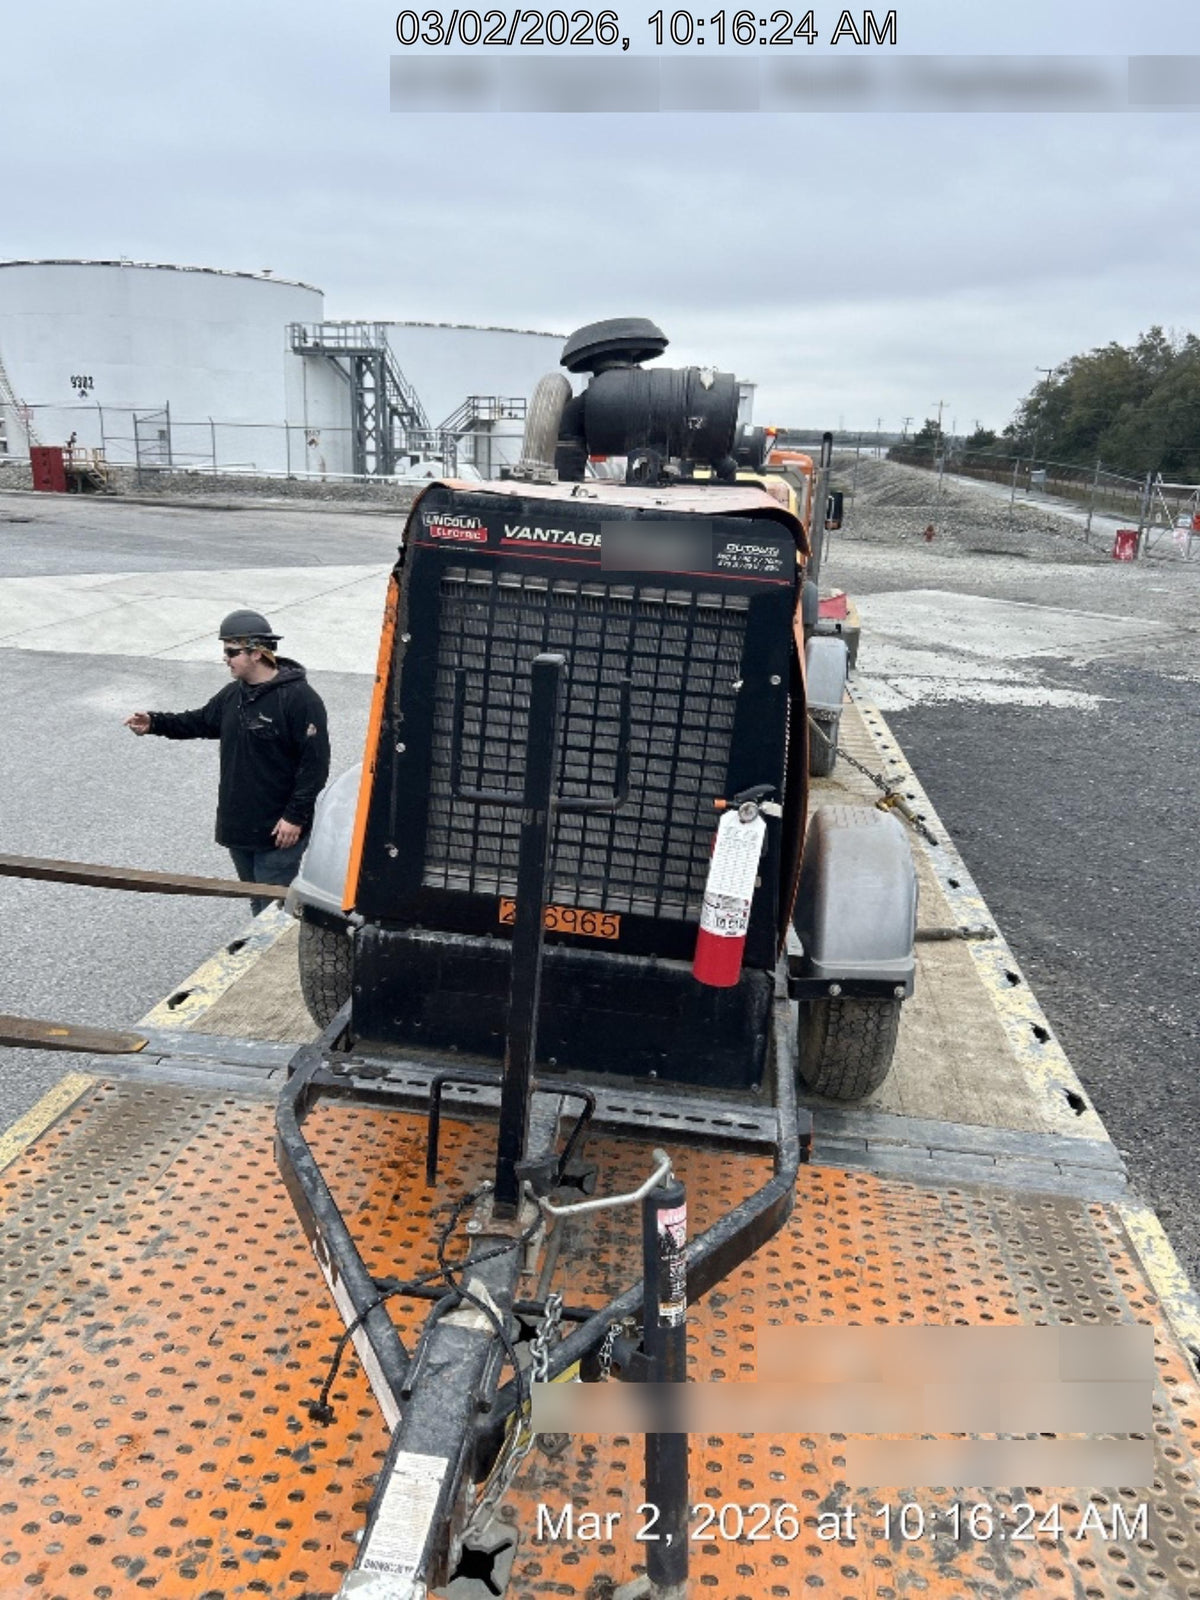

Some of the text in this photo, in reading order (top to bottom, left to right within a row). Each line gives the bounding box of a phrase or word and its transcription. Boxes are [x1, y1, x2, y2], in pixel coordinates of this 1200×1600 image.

[425, 514, 477, 529] LINCOLN
[436, 527, 482, 540] ELECTRIC
[502, 900, 617, 937] 26965
